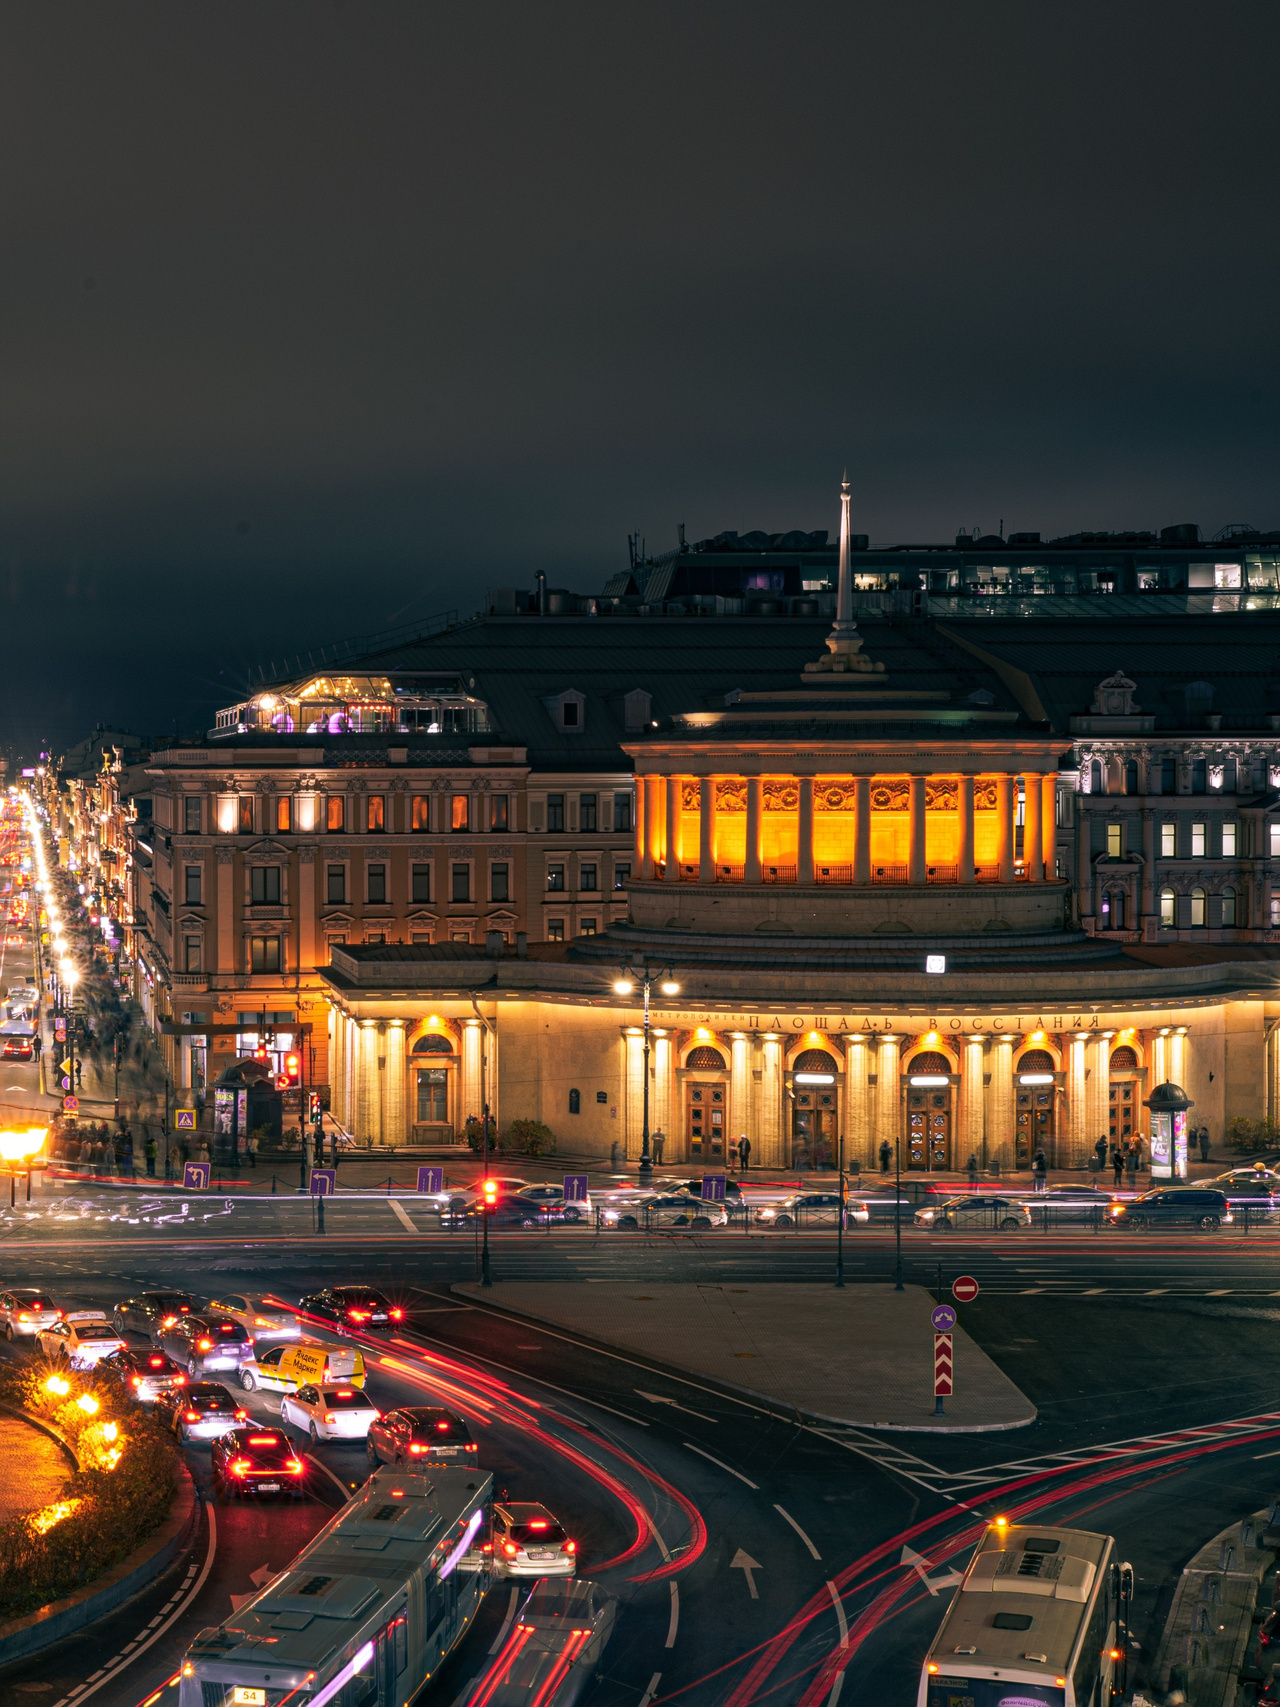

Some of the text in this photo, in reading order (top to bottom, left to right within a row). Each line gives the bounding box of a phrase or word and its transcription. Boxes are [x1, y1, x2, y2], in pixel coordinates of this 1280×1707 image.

[652, 1012, 745, 1021] МЕТРОПОЛИТЕН
[749, 1015, 1099, 1030] ПЛОЩАДЬ ВОССТАНИЯ
[295, 1350, 319, 1366] Яндекс
[292, 1359, 317, 1375] Маркет
[930, 1678, 968, 1687] ЗАКАЗНОЙ
[243, 1691, 257, 1700] 54
